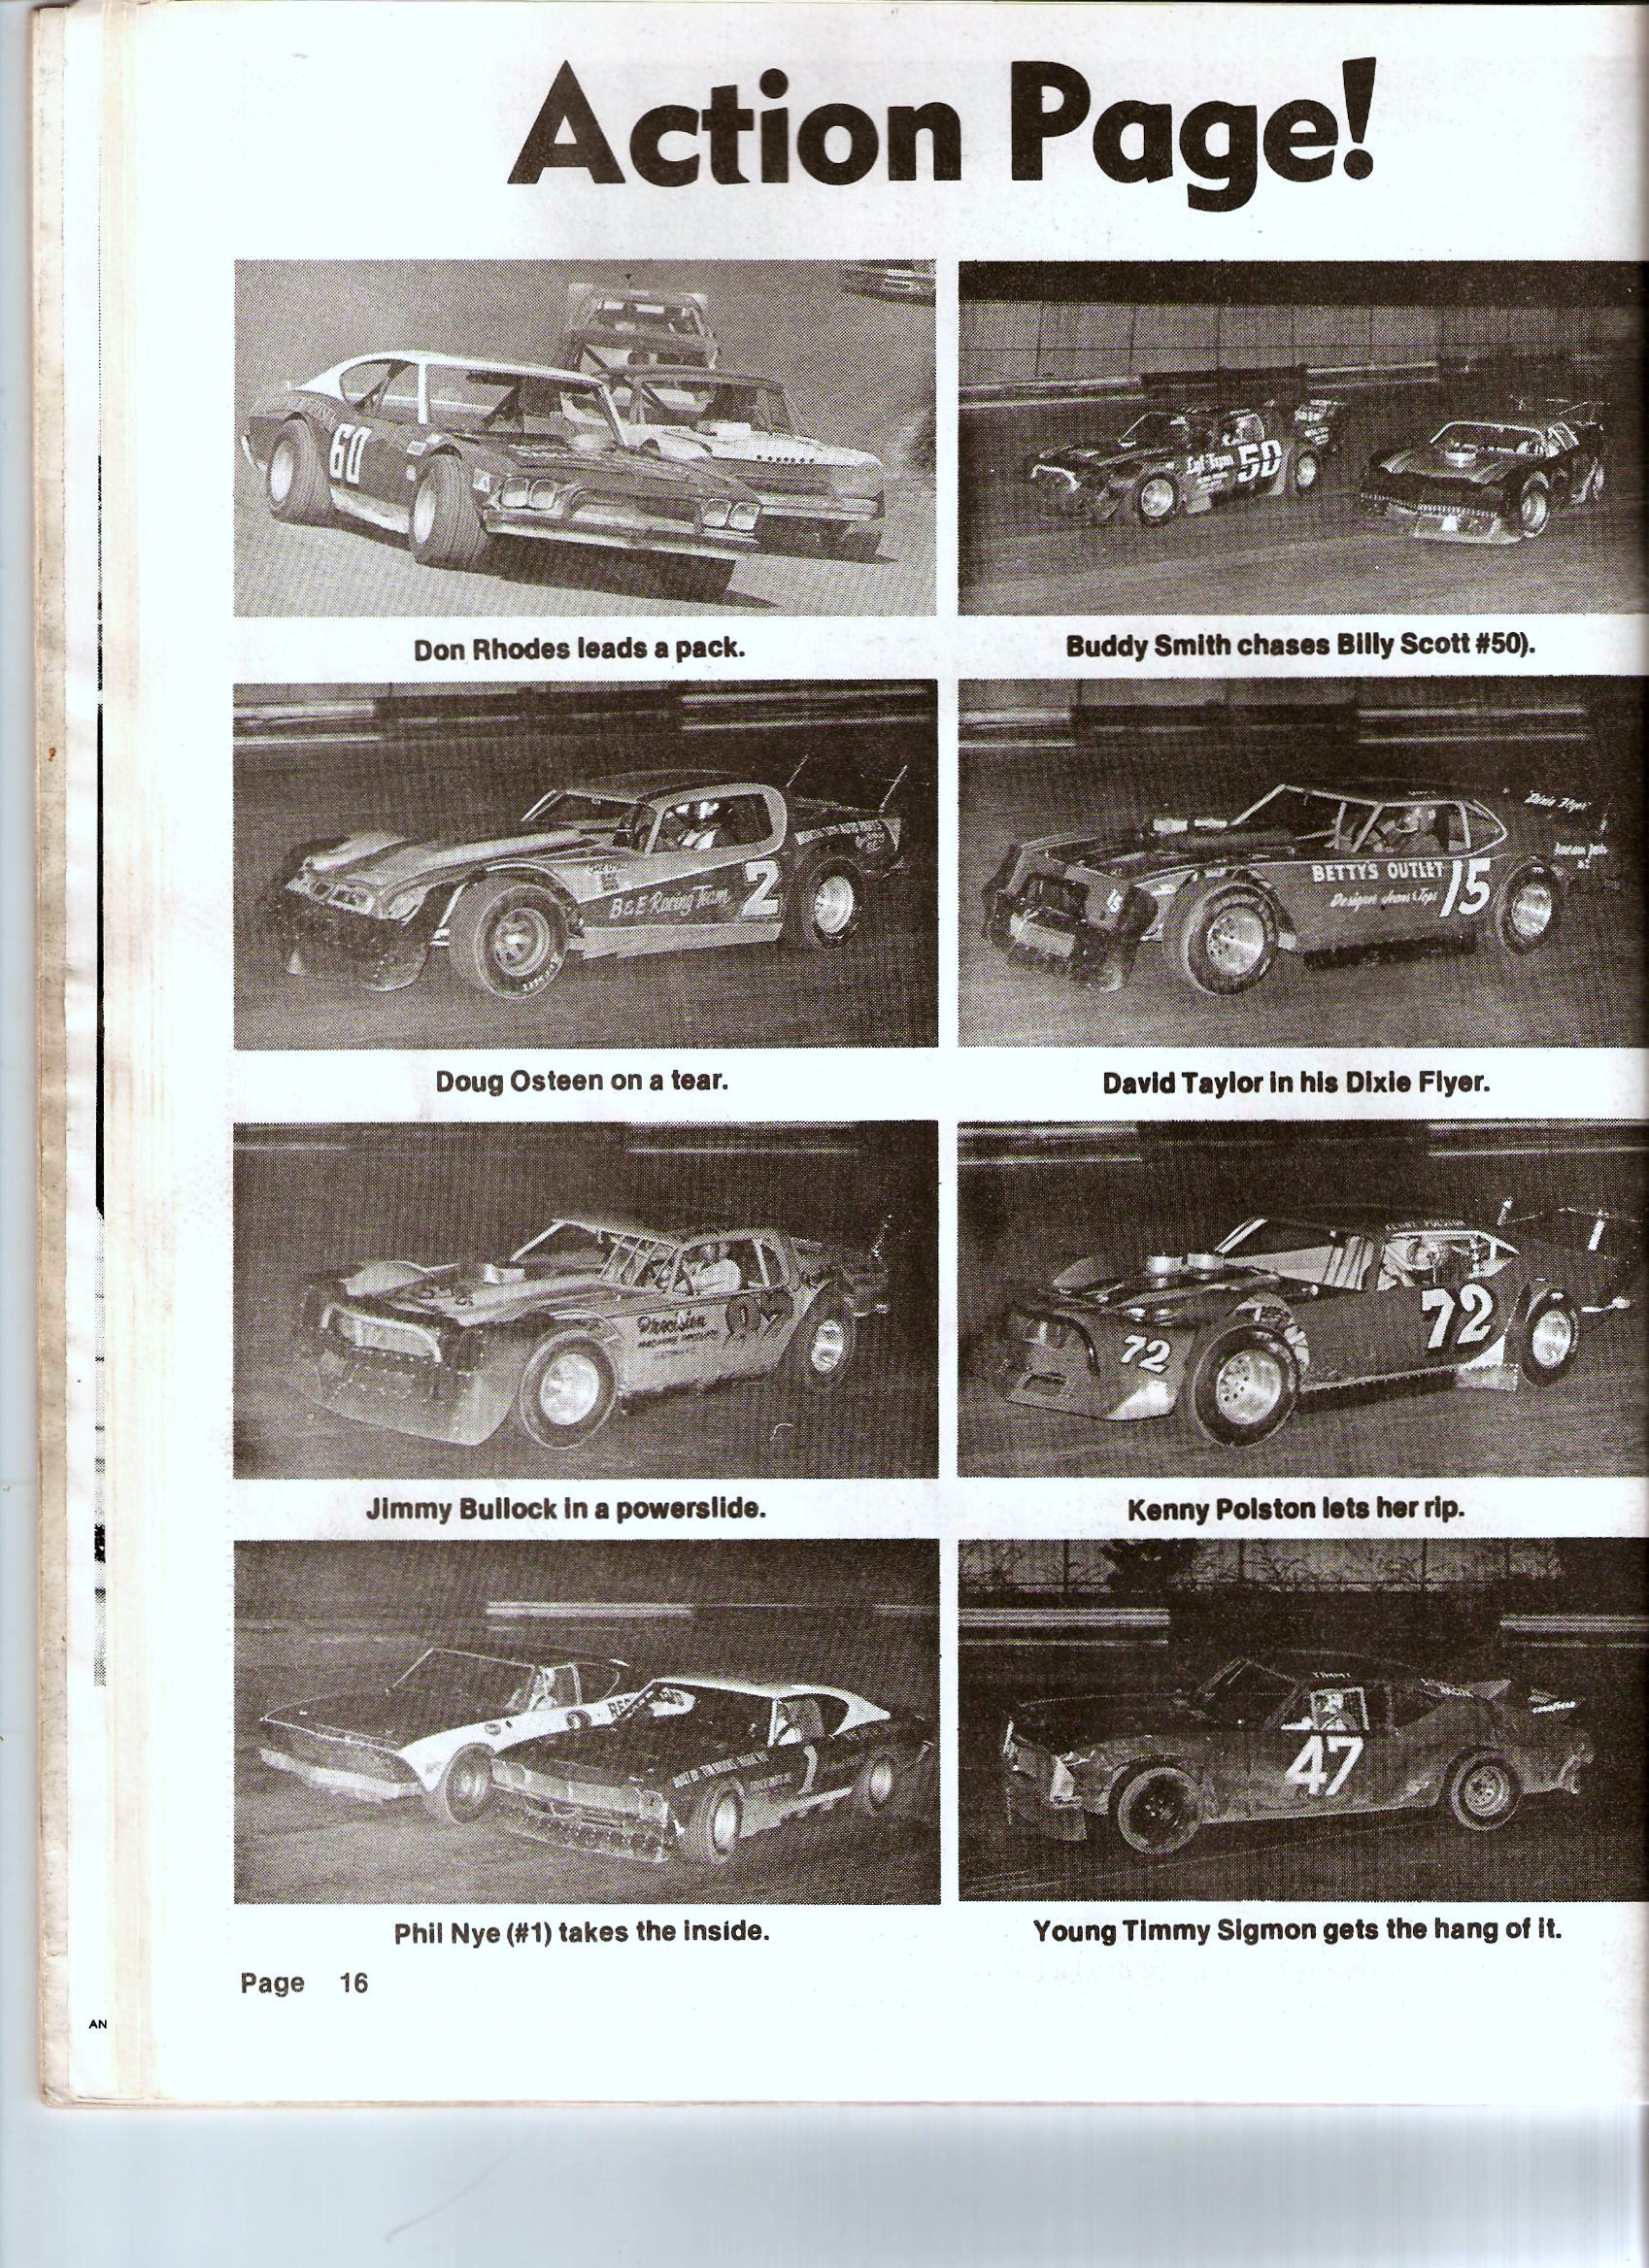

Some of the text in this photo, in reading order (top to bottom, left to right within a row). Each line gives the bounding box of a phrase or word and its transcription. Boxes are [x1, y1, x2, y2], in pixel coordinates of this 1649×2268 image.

[507, 57, 1376, 212] Action Page!
[329, 423, 372, 484] 60
[1237, 440, 1282, 483] 50
[416, 636, 745, 662] Don Rhodes leads a pack.
[1067, 632, 1534, 662] Buddy Smith chases Billy Scott #50).
[1312, 861, 1442, 883] BETTY'S OUTLET
[741, 860, 779, 917] 2
[1439, 858, 1491, 917] 15
[437, 1070, 727, 1096] Doug Osteen on a tear.
[1104, 1071, 1490, 1099] David Taylor in his Dixie Flyer.
[1422, 1283, 1494, 1349] 72
[1120, 1334, 1170, 1374] 72
[367, 1496, 765, 1524] Jimmy Bullock in a powerslide.
[1128, 1496, 1464, 1525] Kenny Polston lets her rip.
[1285, 1735, 1363, 1795] 47
[395, 1919, 769, 1948] Phil Nye (#1) takes the inside.
[1033, 1918, 1561, 1946] Young Timmy Sigmon gets the hang of it.
[242, 1973, 367, 1997] Page 16
